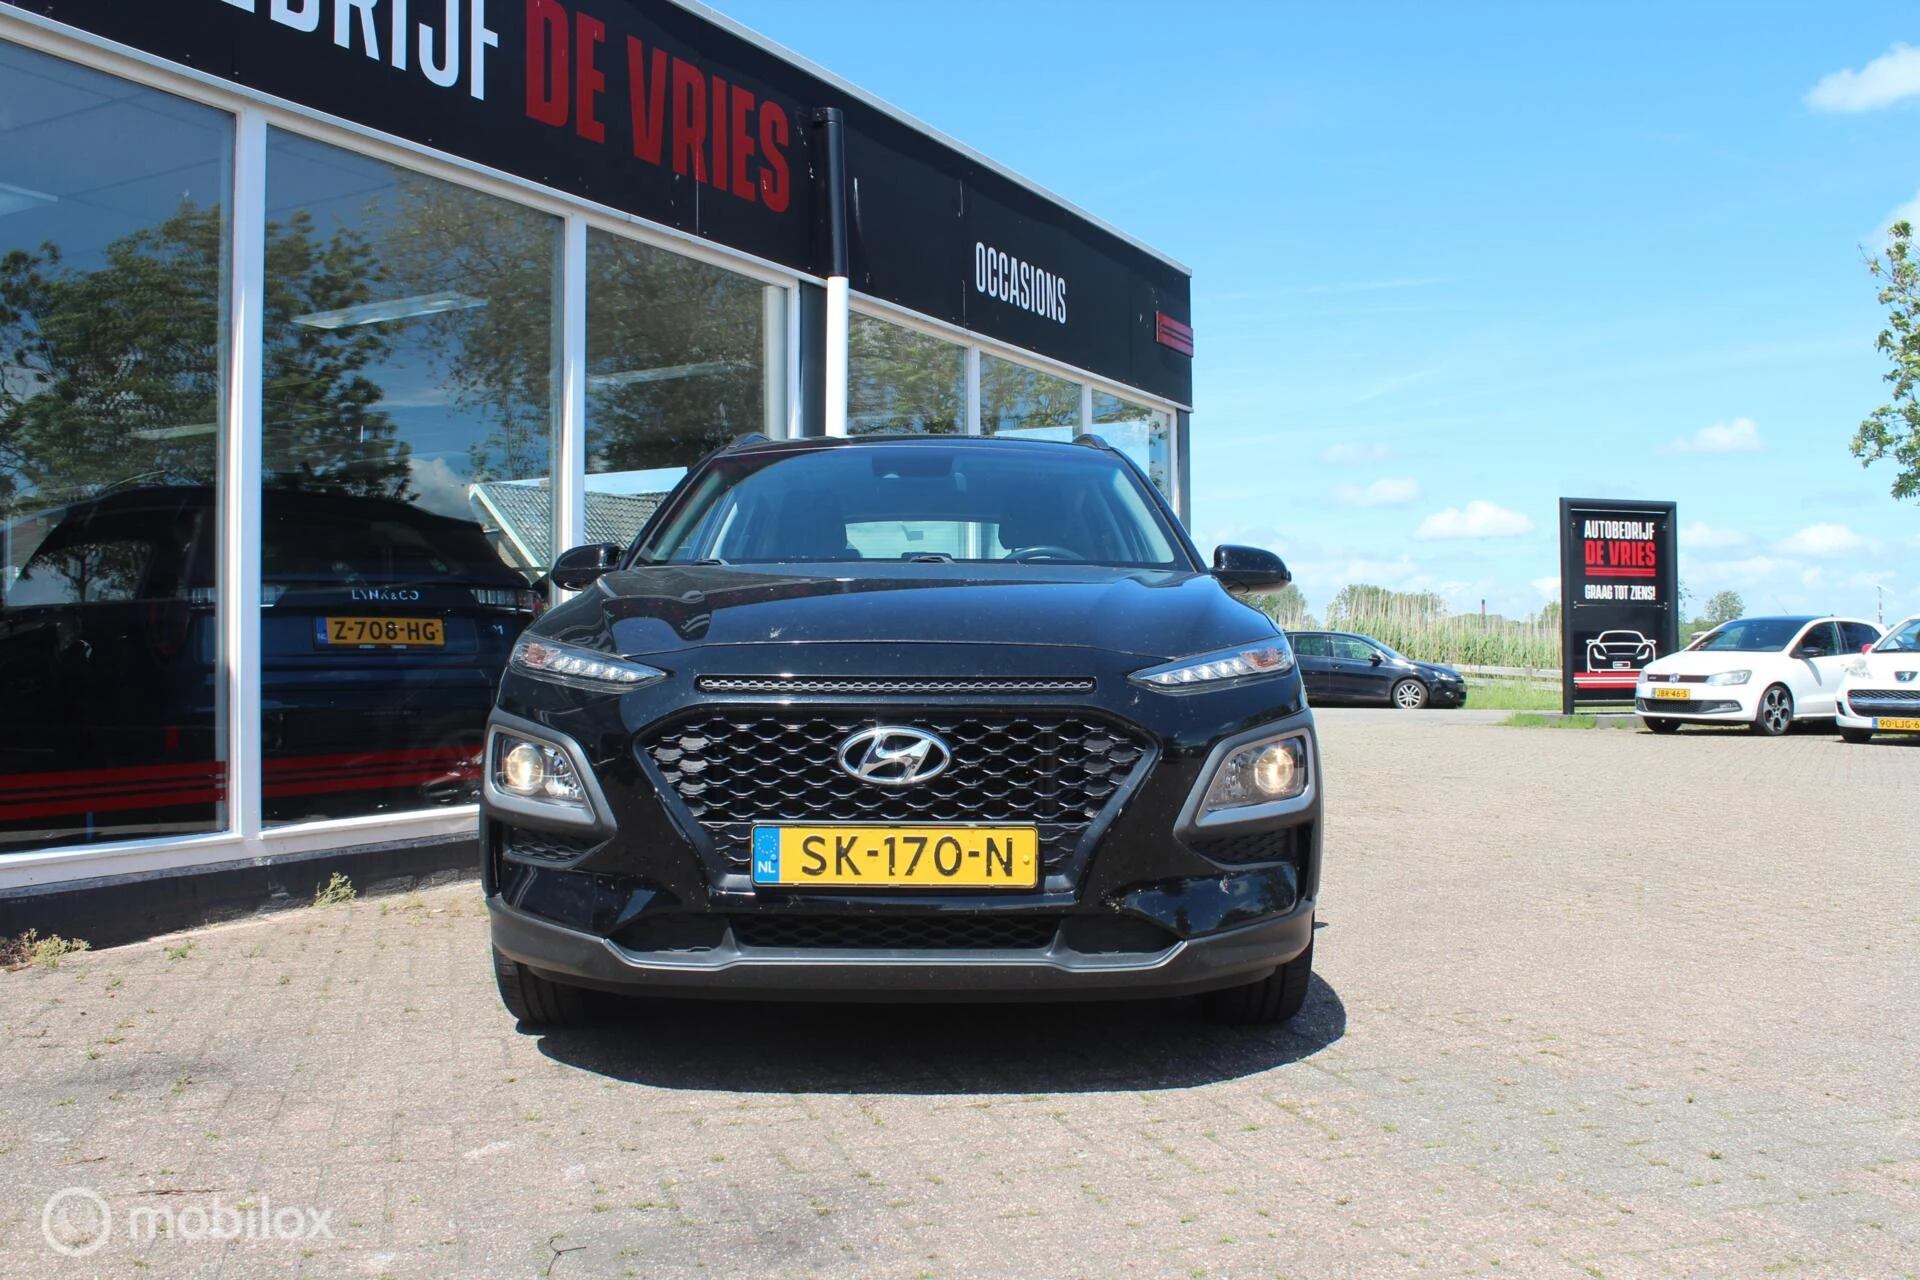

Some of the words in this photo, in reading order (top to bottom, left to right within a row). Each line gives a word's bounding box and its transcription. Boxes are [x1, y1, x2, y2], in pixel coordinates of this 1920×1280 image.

[526, 0, 605, 145] DE
[627, 34, 790, 213] VRIES
[975, 241, 1067, 325] OCCASIONS
[1584, 520, 1656, 540] AUTOBEDRIJF
[1585, 541, 1605, 566] DE
[1608, 541, 1657, 567] VRIES
[1584, 585, 1613, 600] GRAAG
[1614, 586, 1629, 600] TOT
[1630, 586, 1657, 600] ZIENS!
[333, 620, 436, 641] Z-708-HG
[757, 861, 777, 874] NL
[801, 835, 1013, 878] SK-170-N
